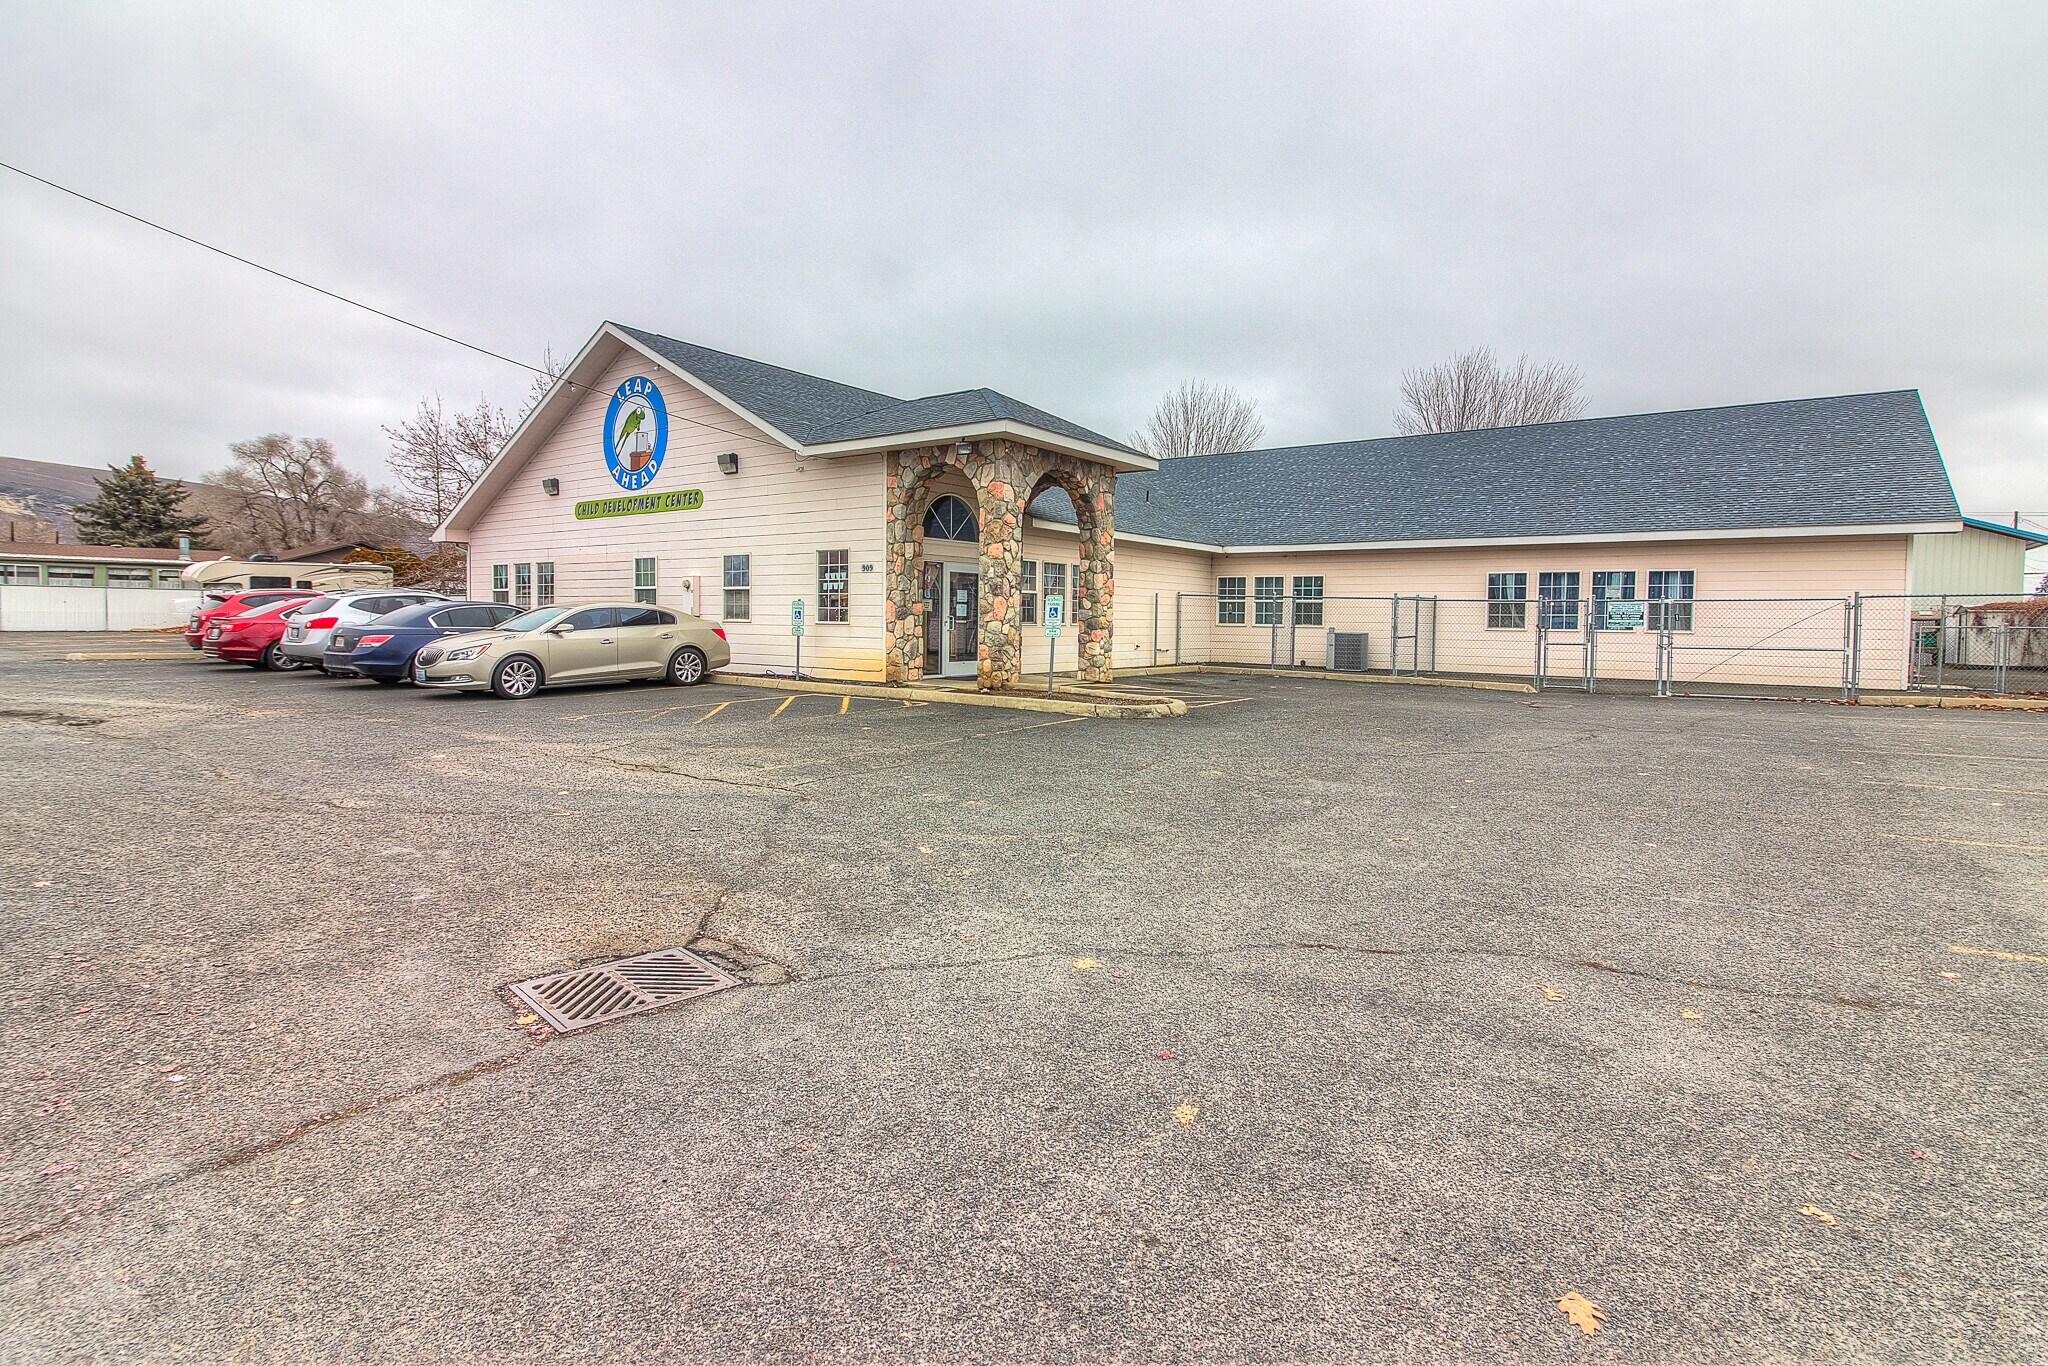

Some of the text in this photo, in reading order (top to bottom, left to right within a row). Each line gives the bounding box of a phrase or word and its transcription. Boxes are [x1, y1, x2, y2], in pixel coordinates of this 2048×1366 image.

[616, 378, 653, 403] LEAP
[612, 459, 658, 489] AHEAD
[577, 491, 700, 517] CHILD DEVELOPMENT CENTER
